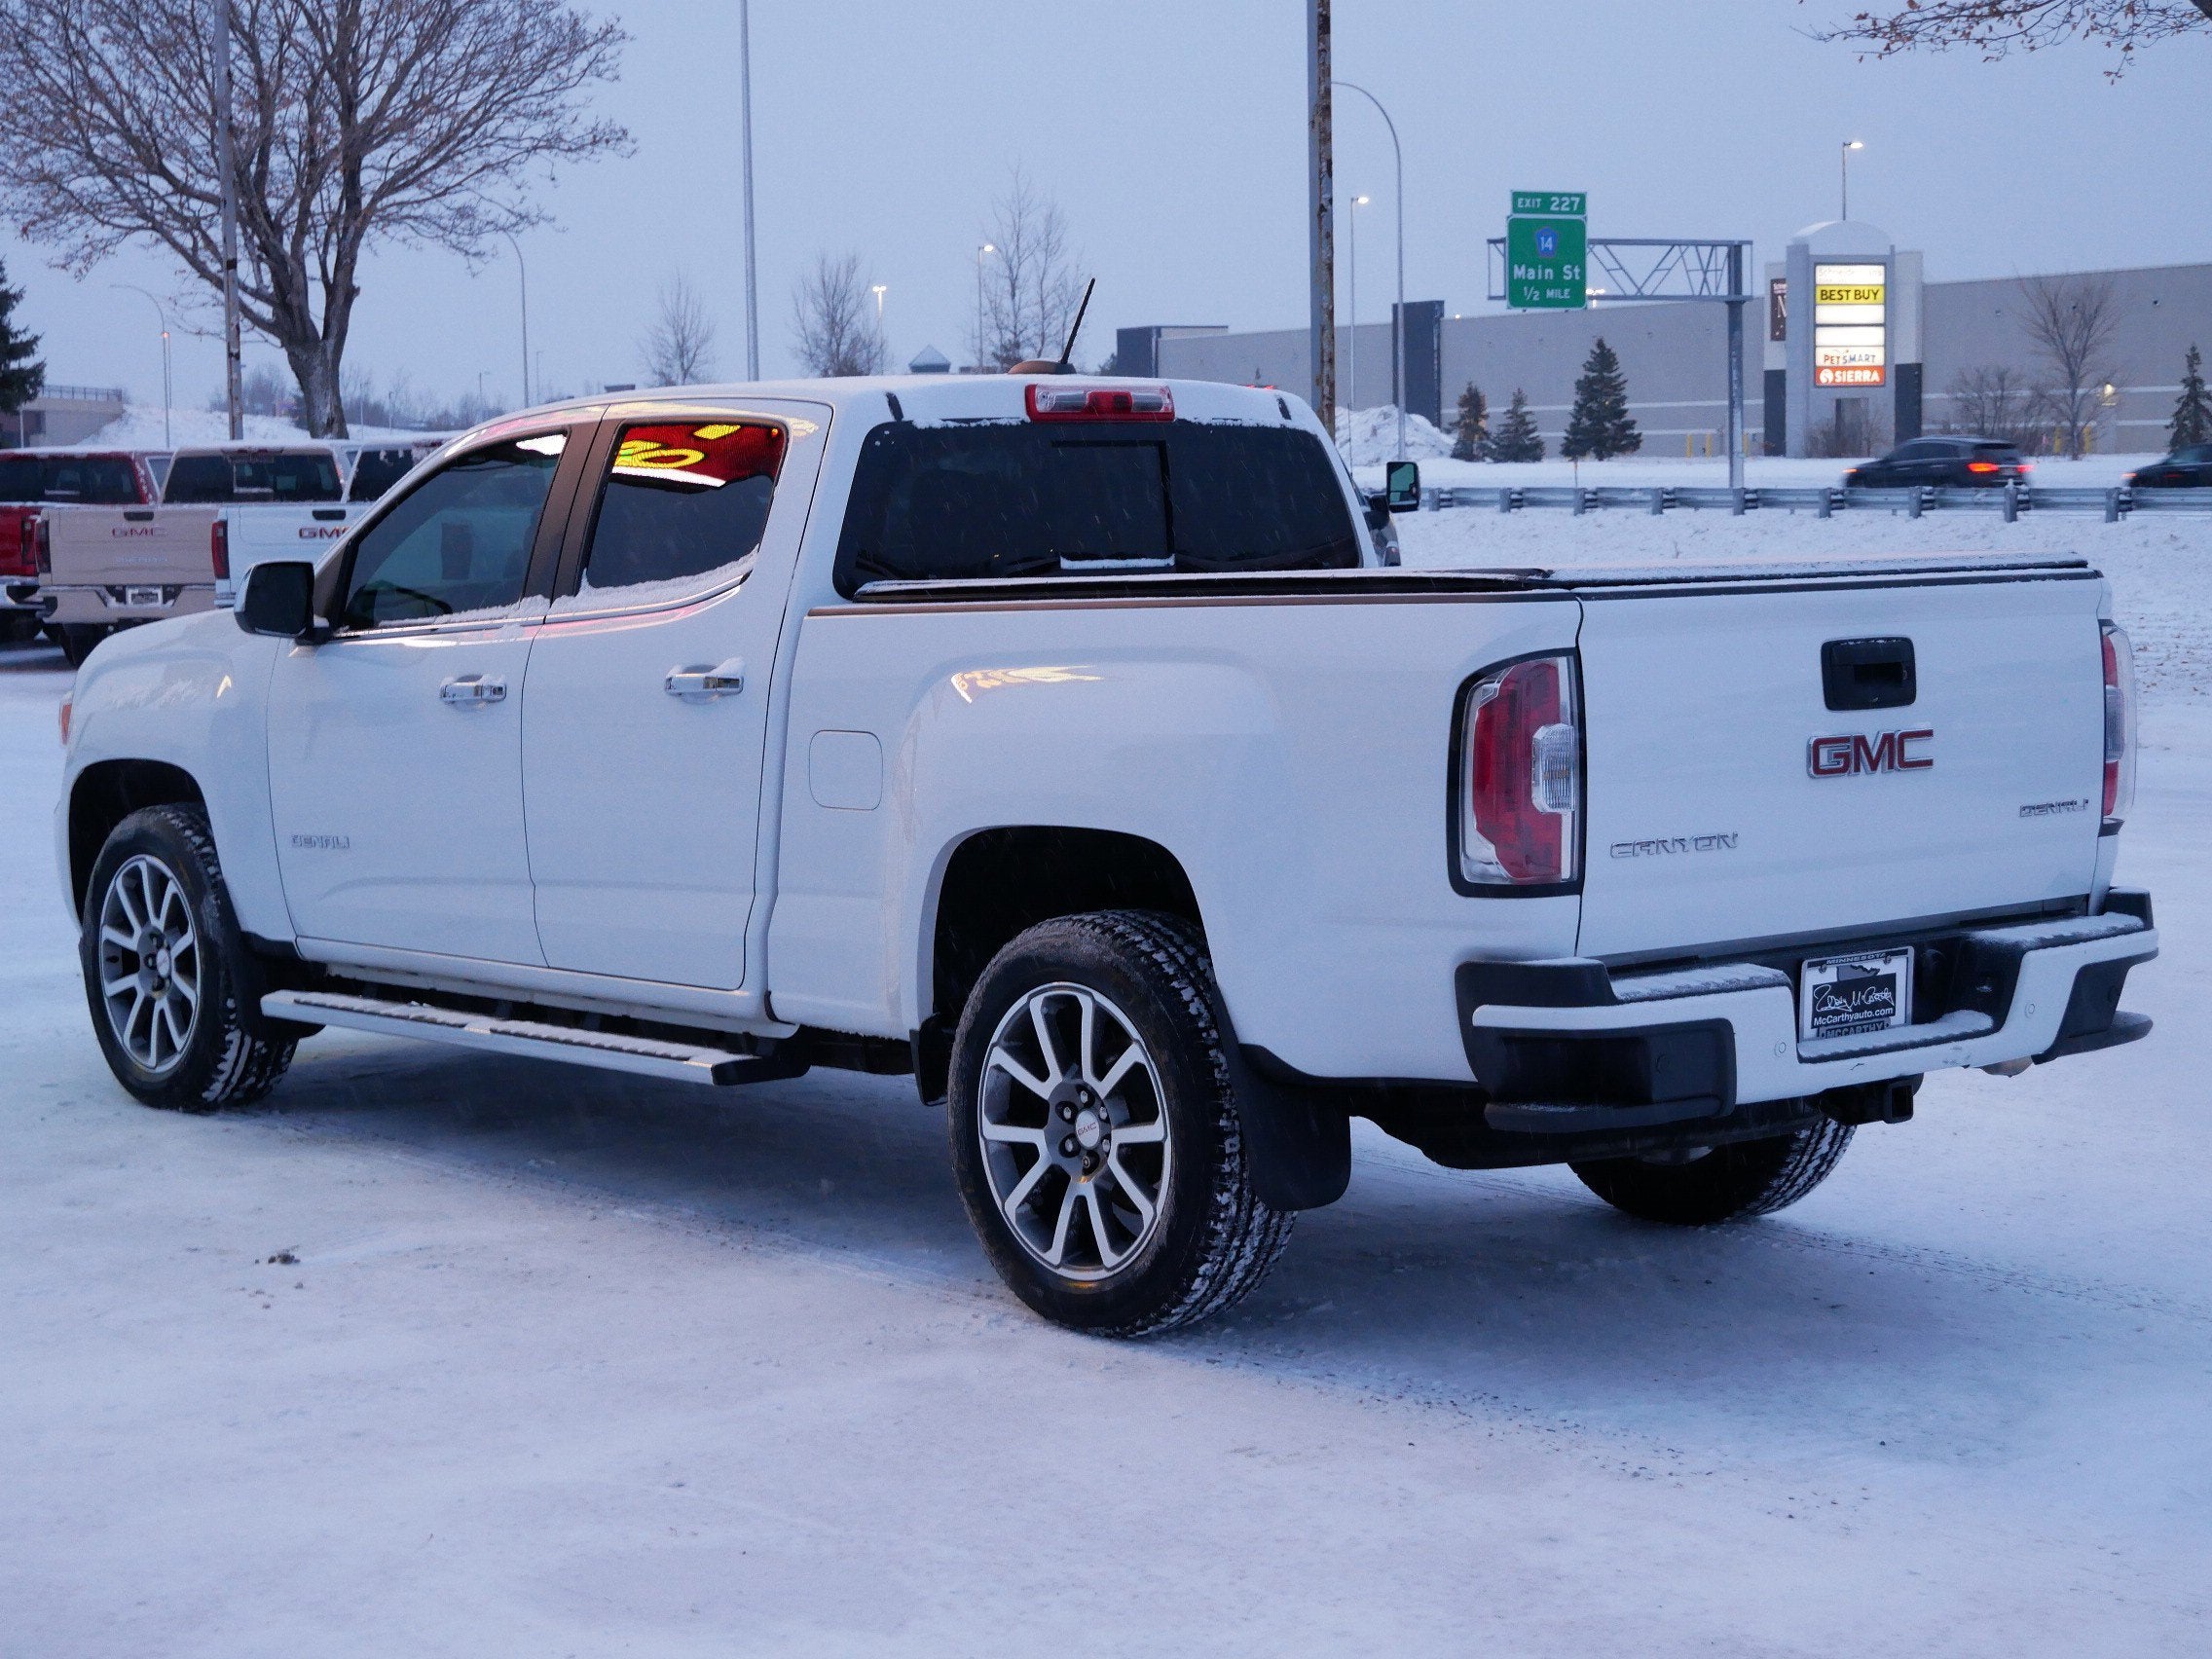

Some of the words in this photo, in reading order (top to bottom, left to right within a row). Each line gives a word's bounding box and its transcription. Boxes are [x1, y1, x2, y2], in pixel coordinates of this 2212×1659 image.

[1517, 198, 1541, 208] EXIT
[1550, 197, 1580, 211] 227
[1540, 237, 1552, 251] 14
[1513, 264, 1553, 279] Main
[1563, 265, 1581, 280] St
[1546, 288, 1570, 299] MILE
[1821, 289, 1851, 301] BEST
[1854, 288, 1879, 300] BUY
[1834, 370, 1880, 384] SIERRA
[1806, 729, 1934, 779] GMC
[1610, 832, 1739, 858] CANYON
[1826, 953, 1886, 965] MINNESOTA
[1814, 1008, 1893, 1026] McCarthyauto.com
